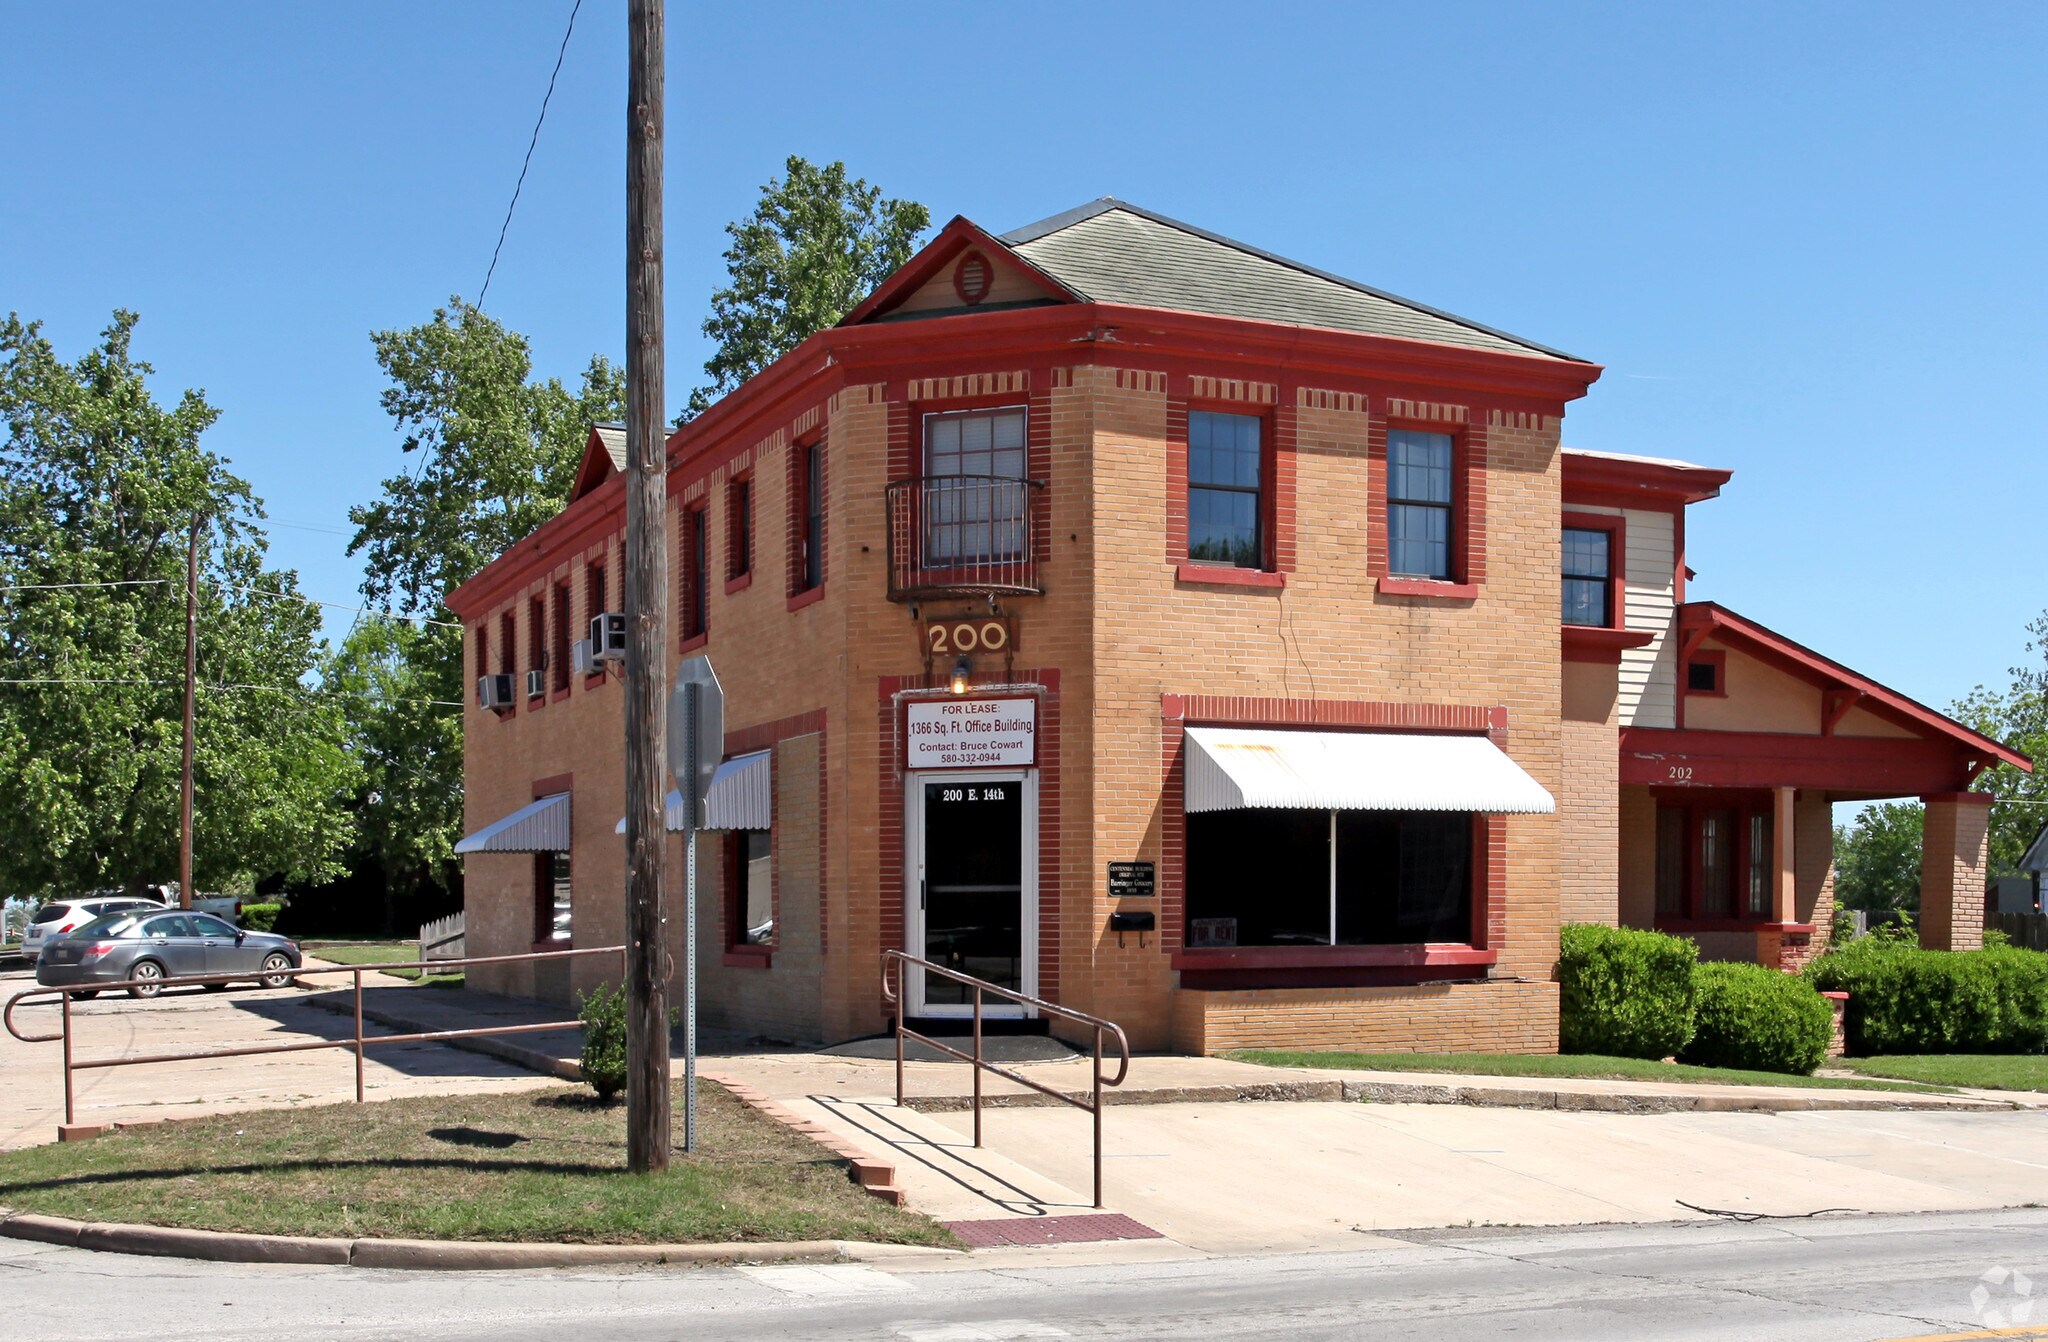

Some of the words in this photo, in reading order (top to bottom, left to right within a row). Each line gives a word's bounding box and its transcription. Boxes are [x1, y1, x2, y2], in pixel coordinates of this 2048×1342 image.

[929, 622, 1006, 652] 200
[942, 705, 962, 714] FOR
[965, 704, 1001, 714] LEASE:
[911, 722, 932, 734] 1366
[934, 721, 949, 736] Sq.
[951, 720, 963, 733] Ft.
[965, 720, 992, 733] Office
[994, 718, 1032, 734] Building
[919, 743, 957, 752] Contact:
[960, 741, 988, 751] Bruce
[990, 740, 1023, 750] Cowart
[941, 753, 1001, 763] 580-332-0944
[1669, 766, 1693, 779] 202
[943, 789, 963, 801] 200
[968, 789, 979, 800] E.
[983, 788, 1005, 800] 14th
[1192, 926, 1209, 942] FOR
[1215, 926, 1236, 941] RENT
